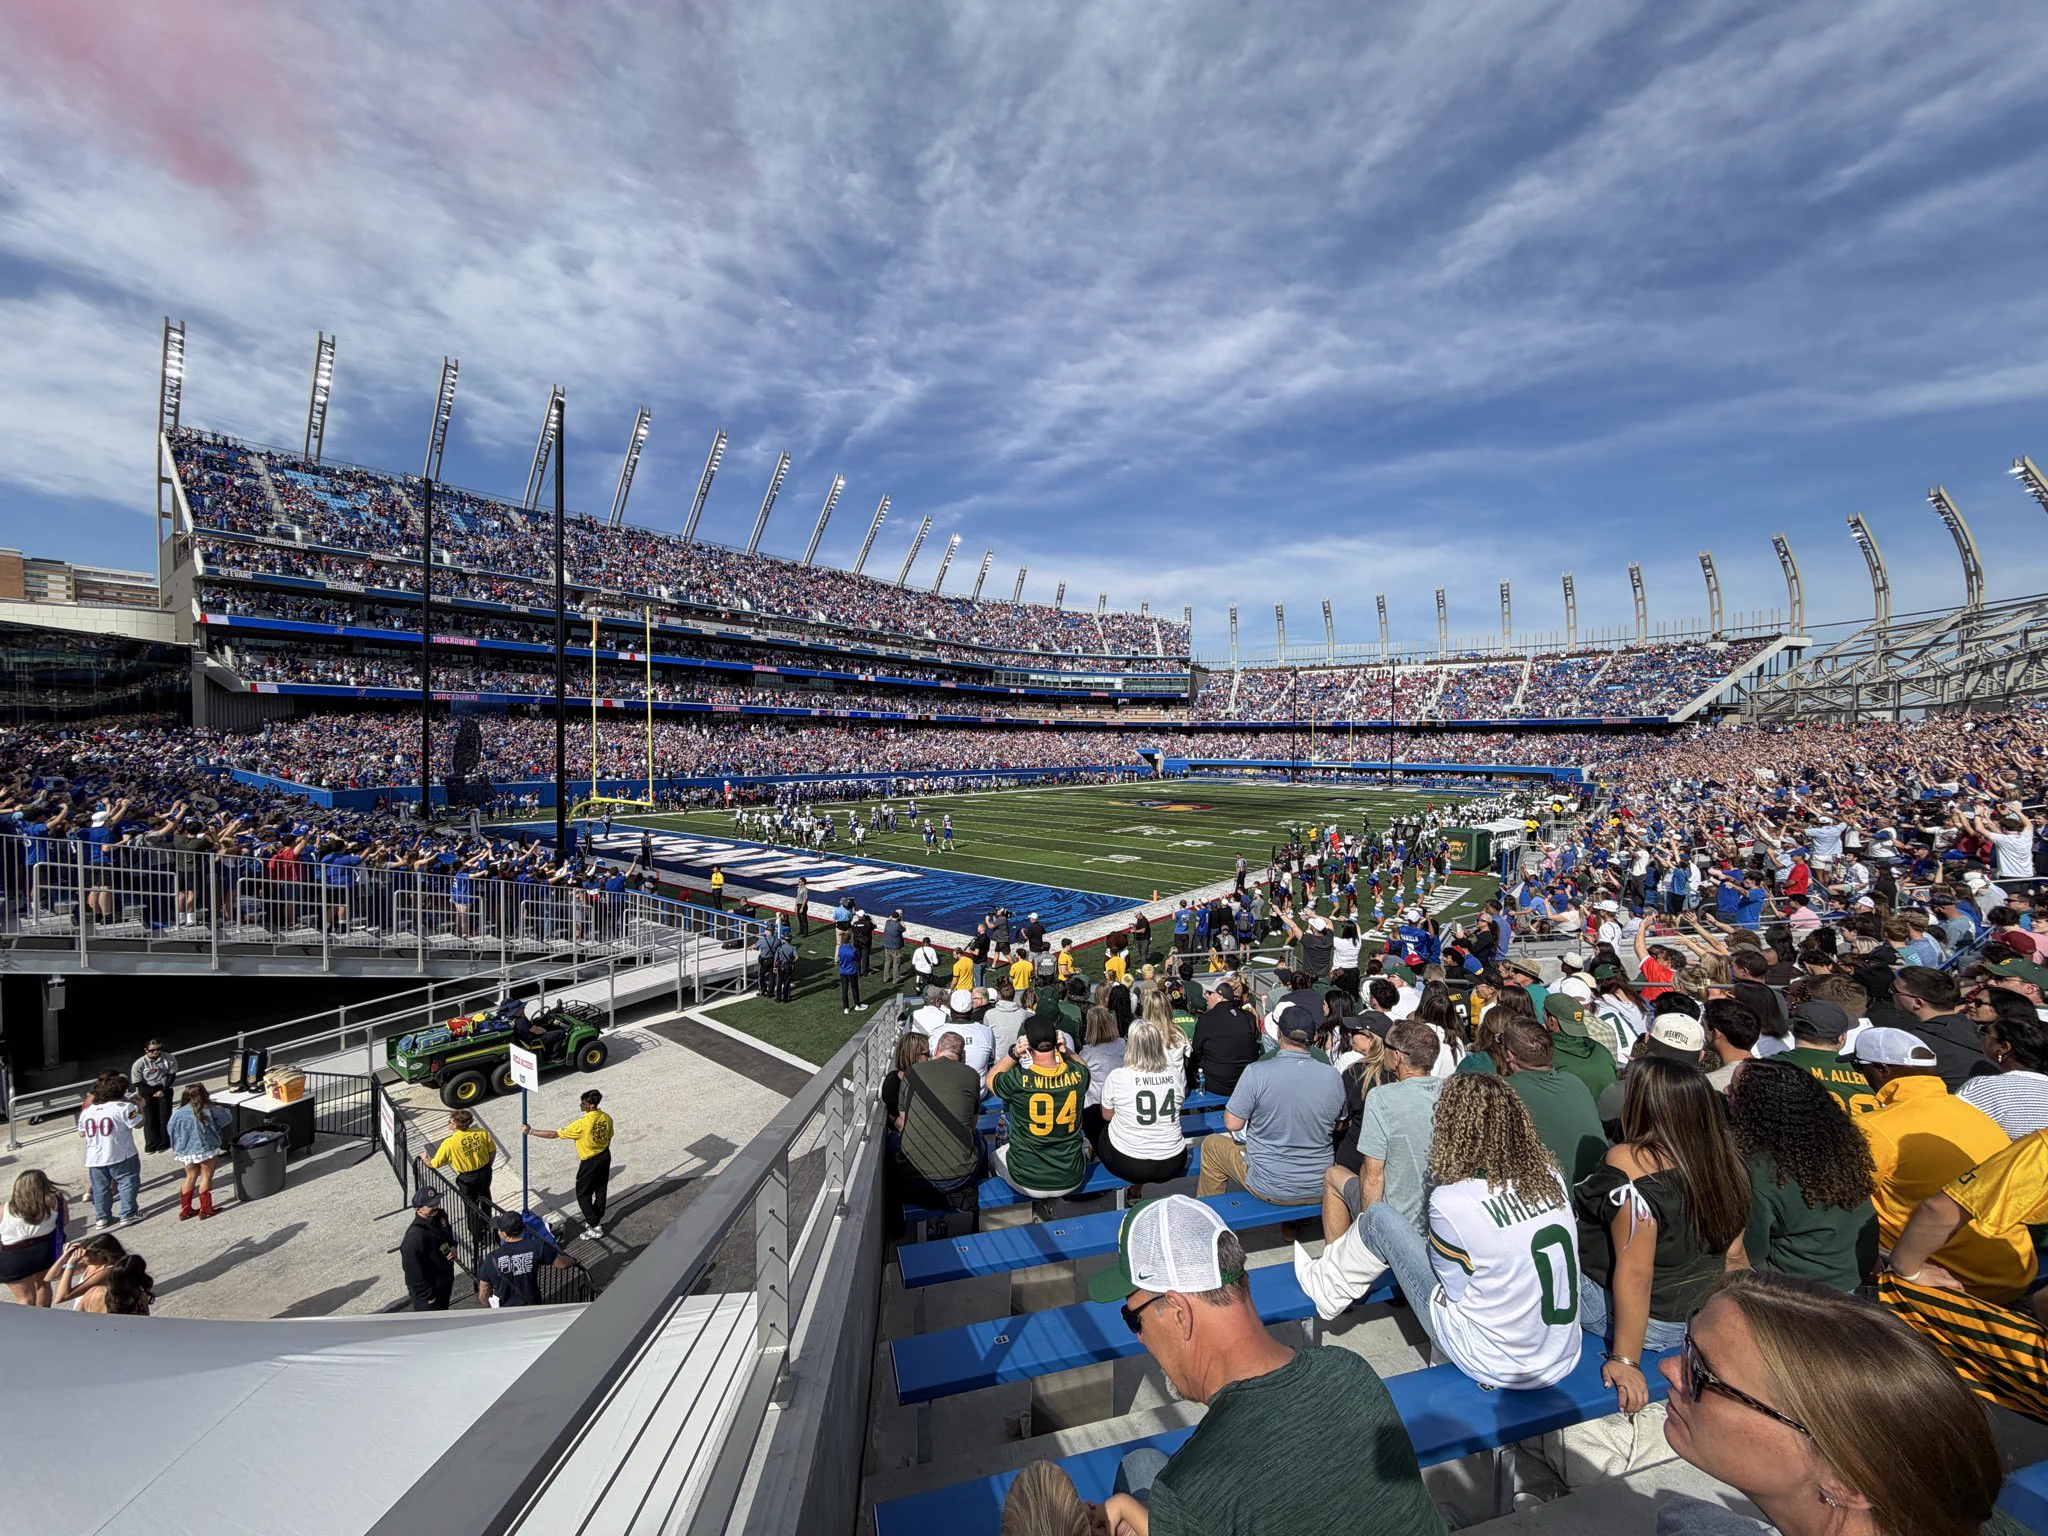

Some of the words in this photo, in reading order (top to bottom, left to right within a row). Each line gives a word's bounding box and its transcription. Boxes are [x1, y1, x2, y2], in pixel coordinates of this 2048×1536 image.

[432, 636, 478, 647] TOUCHDOWN!
[432, 693, 479, 701] TOUCHDOWN!
[1663, 1030, 1689, 1046] DREAMVILLE
[1022, 1075, 1033, 1088] P.
[1034, 1071, 1082, 1089] WILLIAMS
[1135, 1077, 1142, 1086] P.
[1142, 1075, 1175, 1086] WILLIAMS
[1811, 1067, 1829, 1081] M.
[1831, 1069, 1869, 1085] ALLEN
[1028, 1090, 1078, 1136] 94
[1136, 1088, 1177, 1126] 94
[85, 1116, 113, 1138] 00
[461, 1133, 480, 1146] CSC
[498, 1254, 533, 1274] FIRE
[995, 1336, 1008, 1345] 15
